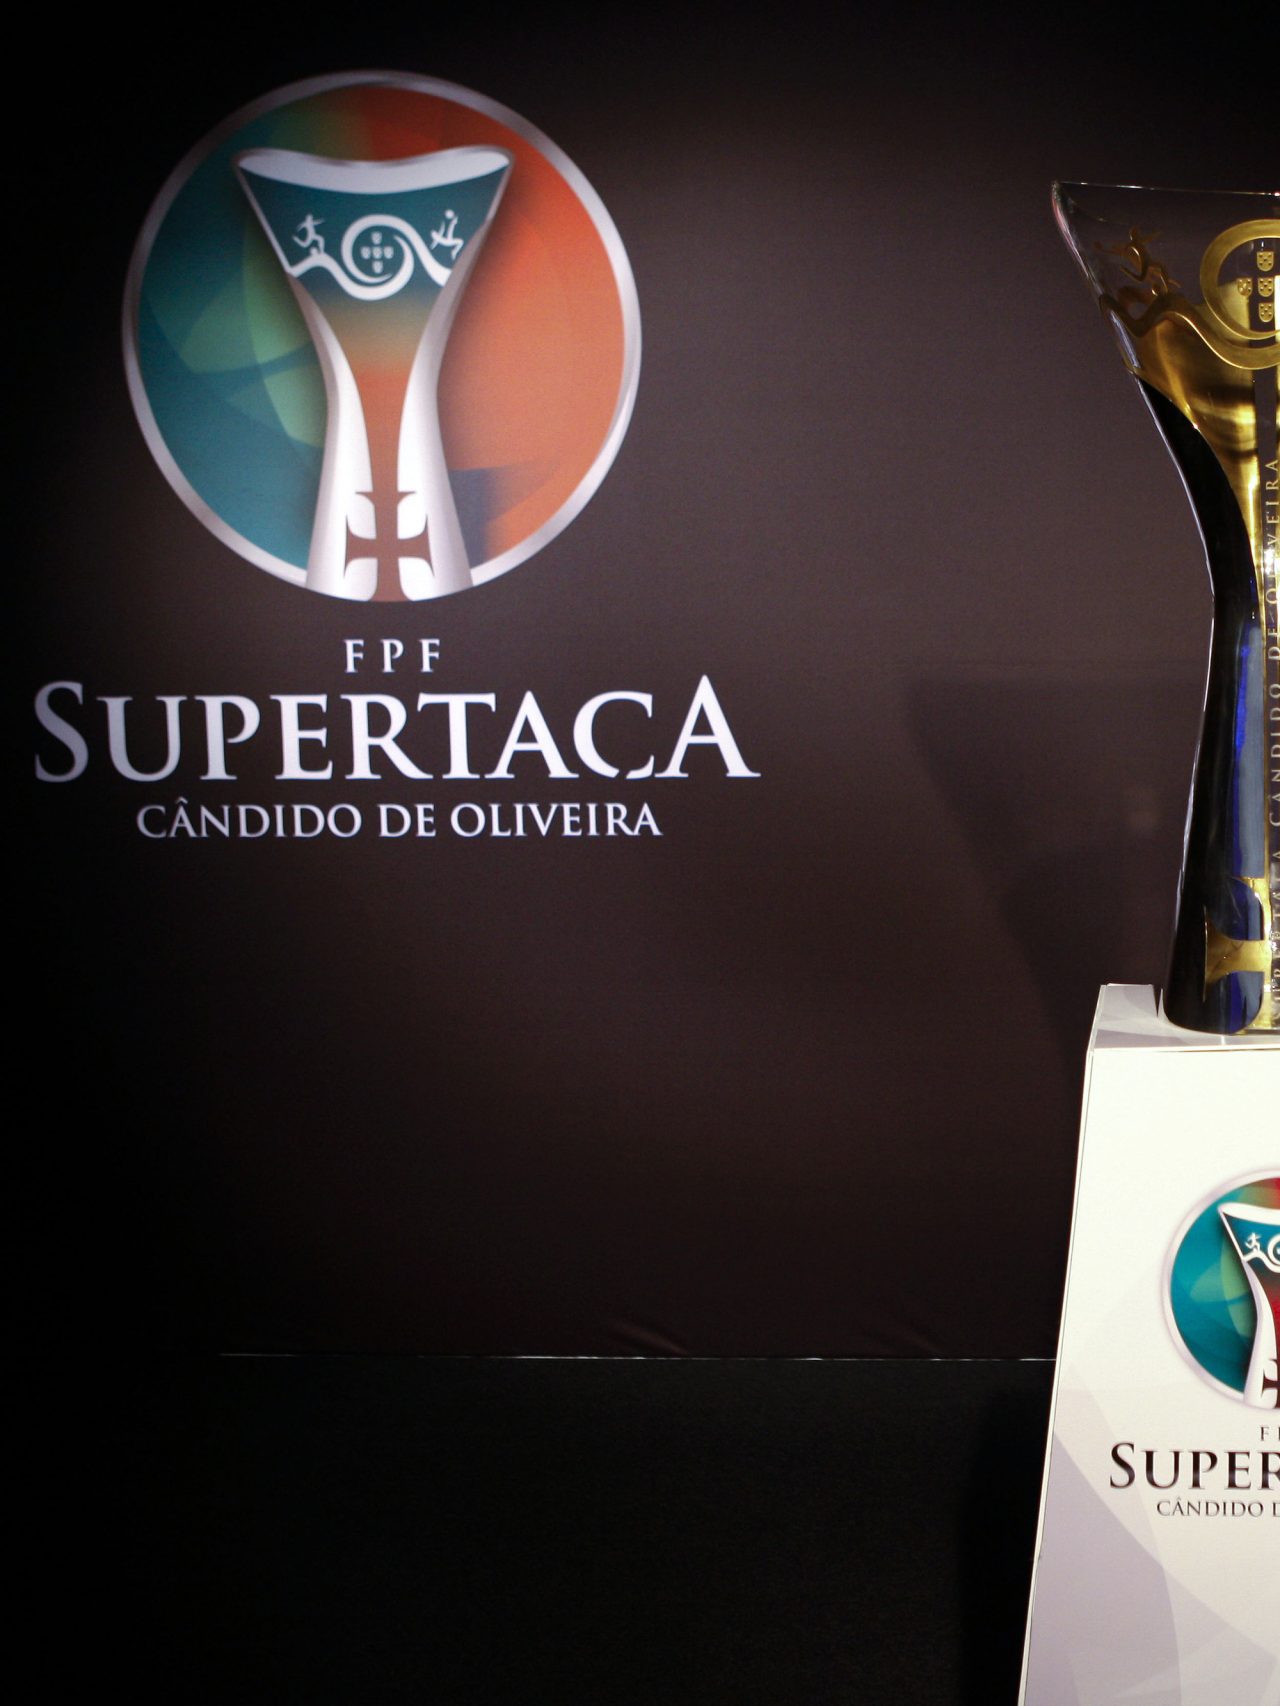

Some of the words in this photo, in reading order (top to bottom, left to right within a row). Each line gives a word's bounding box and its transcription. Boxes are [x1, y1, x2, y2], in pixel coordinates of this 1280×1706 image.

[137, 797, 362, 838] CÂNDIDO
[378, 804, 436, 837] DE
[451, 802, 663, 837] OLIVEIRA
[1157, 1498, 1263, 1516] CÂNDIDO
